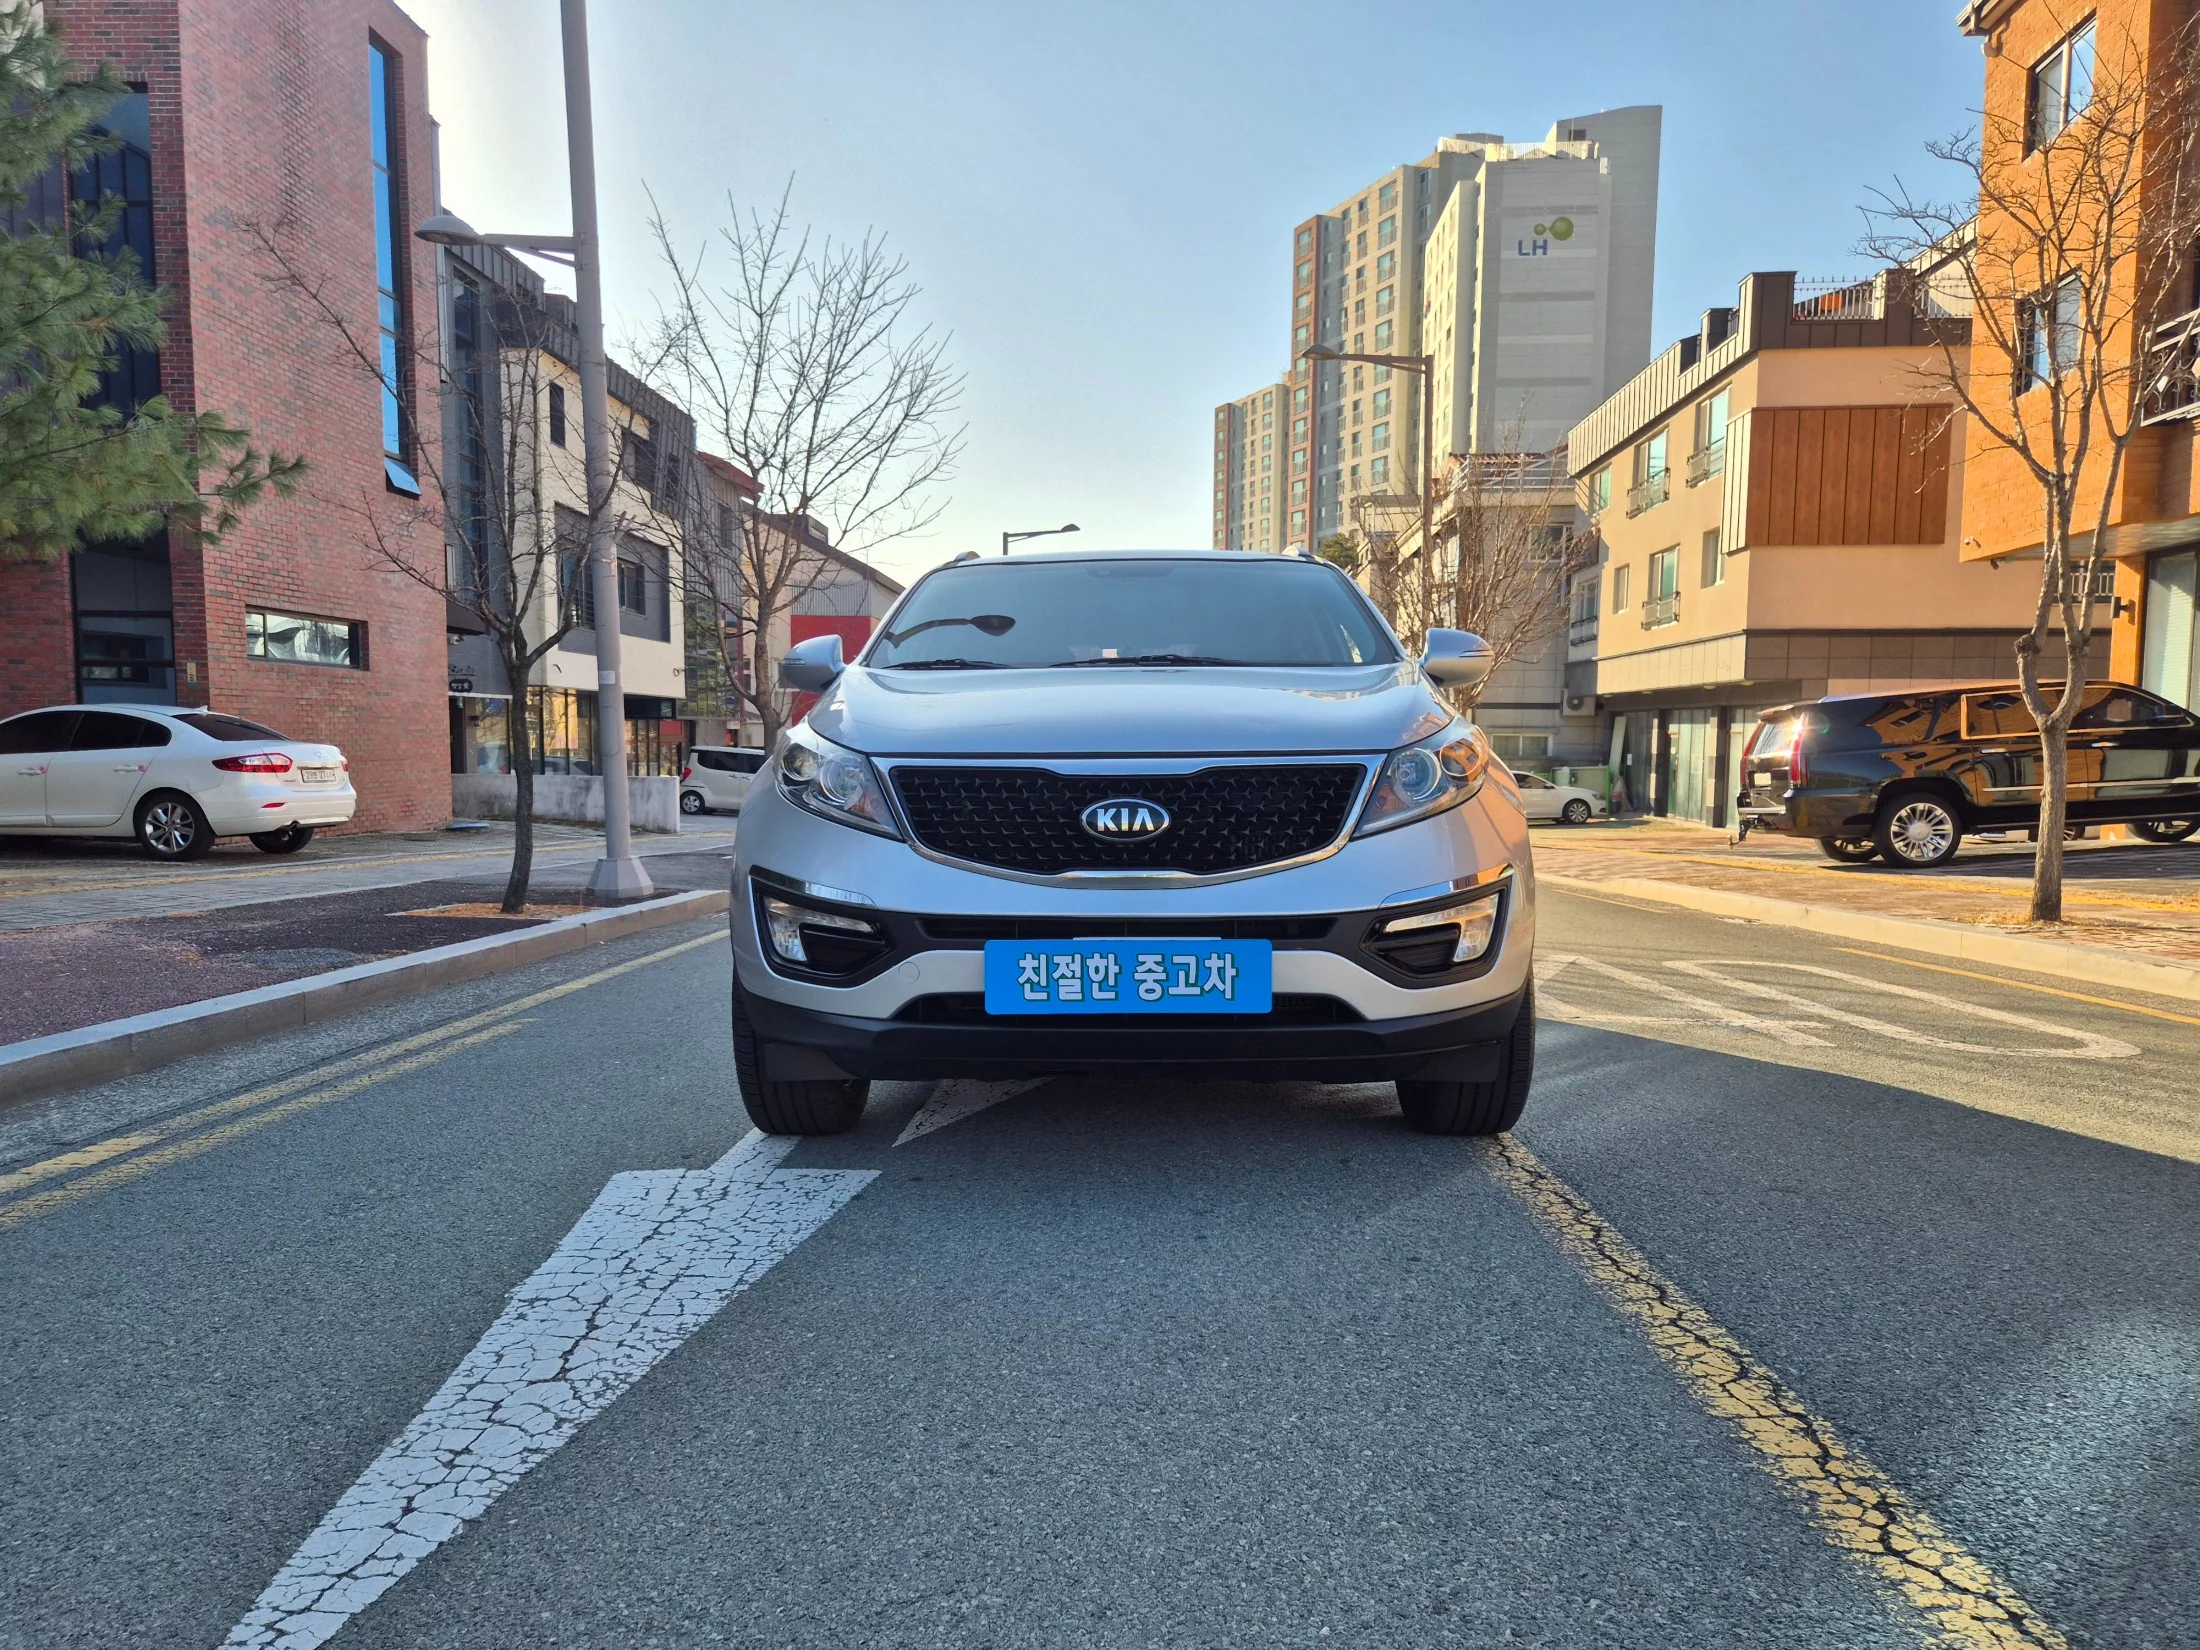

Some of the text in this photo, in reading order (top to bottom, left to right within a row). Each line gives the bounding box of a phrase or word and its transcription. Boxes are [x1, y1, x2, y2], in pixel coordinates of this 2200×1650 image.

[1518, 239, 1548, 256] LH
[1096, 807, 1155, 832] KIA
[1017, 952, 1238, 1001] 친절한 중고차
